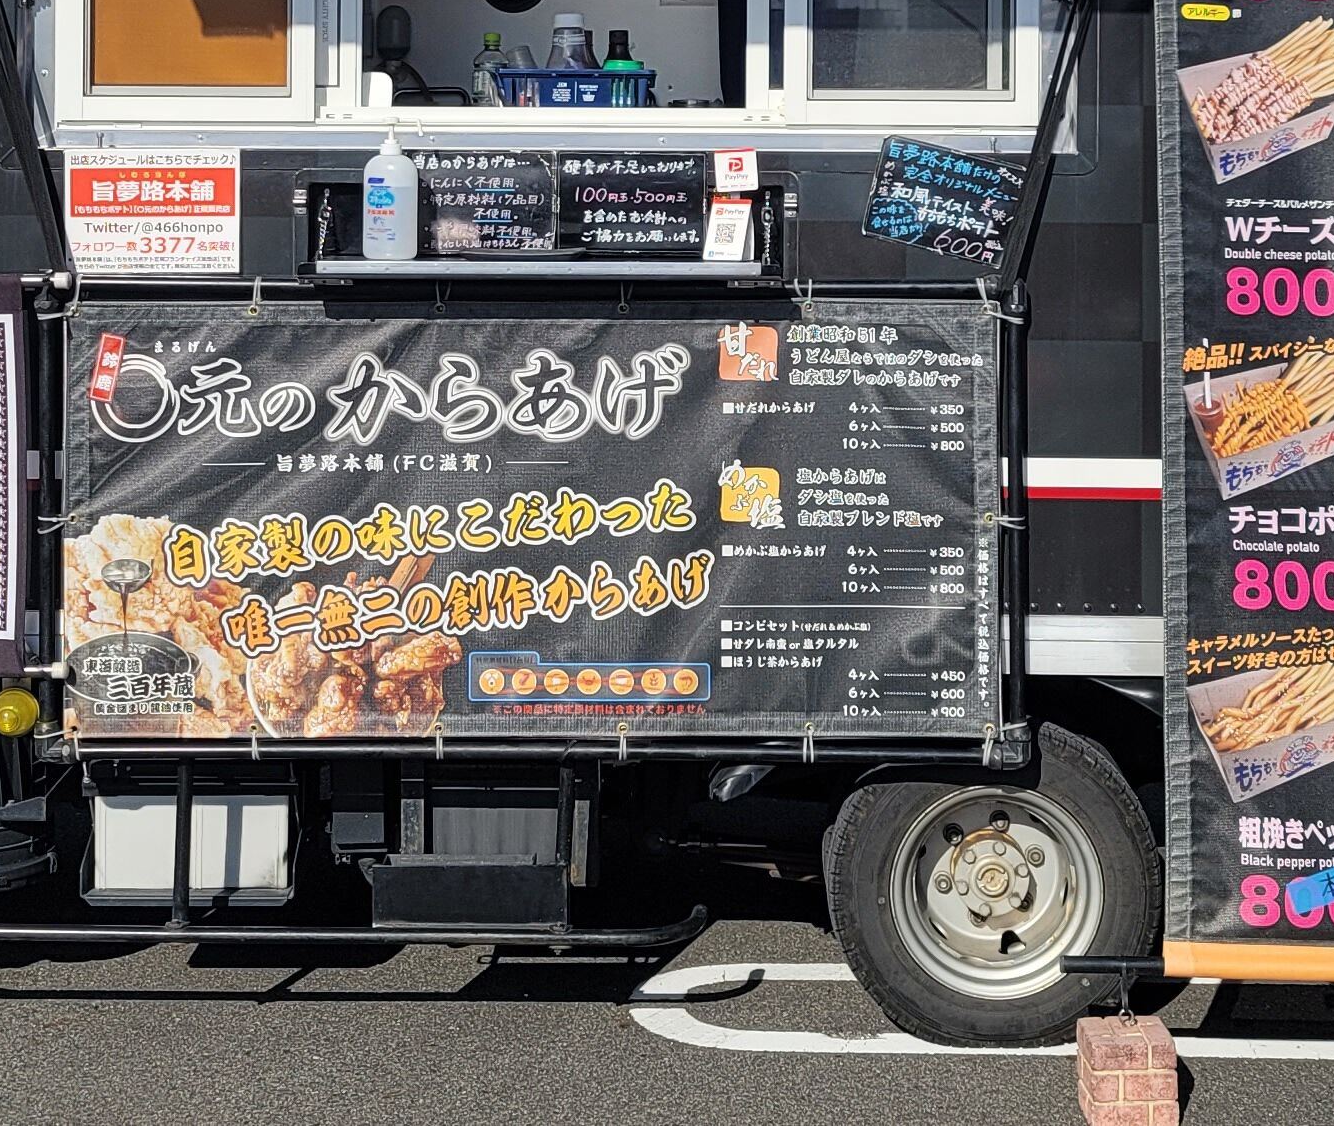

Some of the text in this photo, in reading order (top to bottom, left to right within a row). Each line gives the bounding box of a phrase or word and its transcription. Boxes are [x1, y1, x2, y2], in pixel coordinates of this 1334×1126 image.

[92, 180, 215, 202] 旨夢路本舗
[1224, 248, 1261, 261] Double
[1264, 248, 1302, 261] cheese
[164, 479, 697, 586] 自家製の味にこだわった
[1233, 540, 1320, 554] Chocolate potato
[221, 553, 715, 658] 唯一無二の創作からあげ
[1241, 854, 1316, 870] Black pepper
